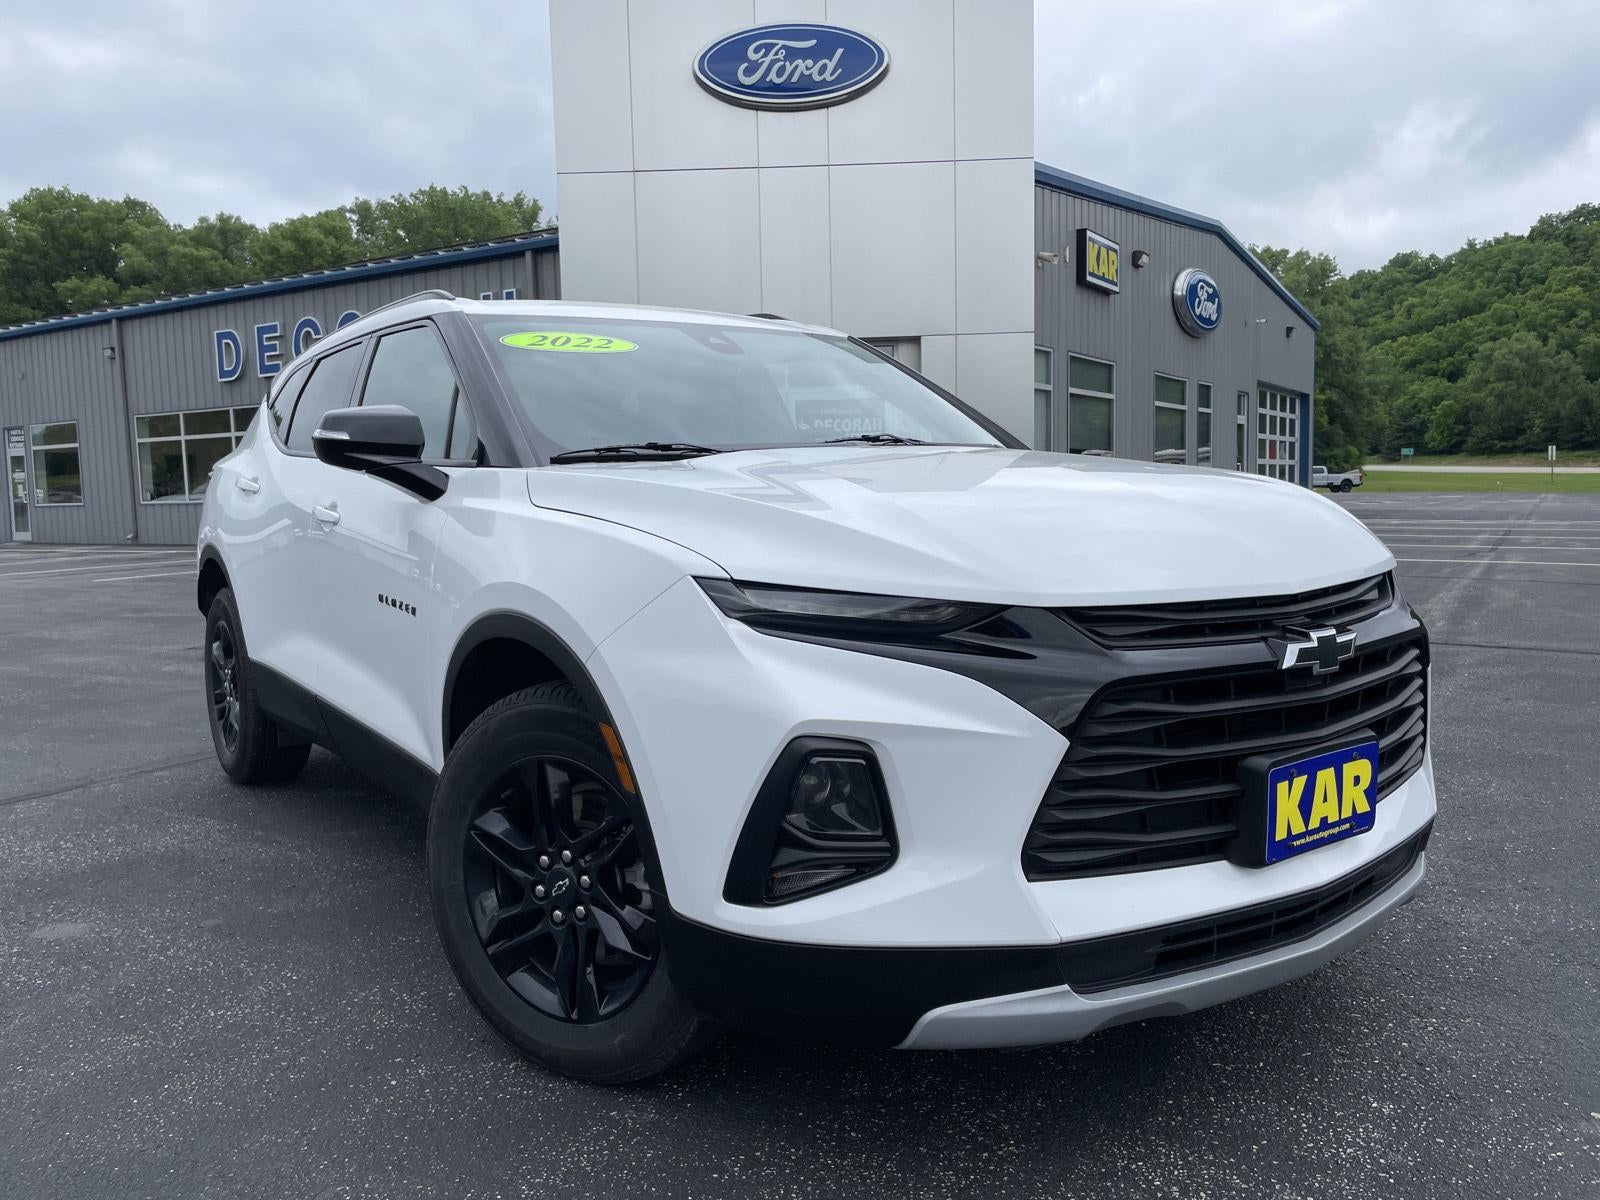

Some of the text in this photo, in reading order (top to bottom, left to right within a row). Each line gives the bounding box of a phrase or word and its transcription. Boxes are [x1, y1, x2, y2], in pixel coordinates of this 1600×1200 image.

[736, 38, 845, 86] Ford
[1088, 240, 1118, 284] KAR
[1195, 281, 1218, 321] Ford
[526, 334, 615, 349] 2022
[1275, 758, 1372, 841] KAR
